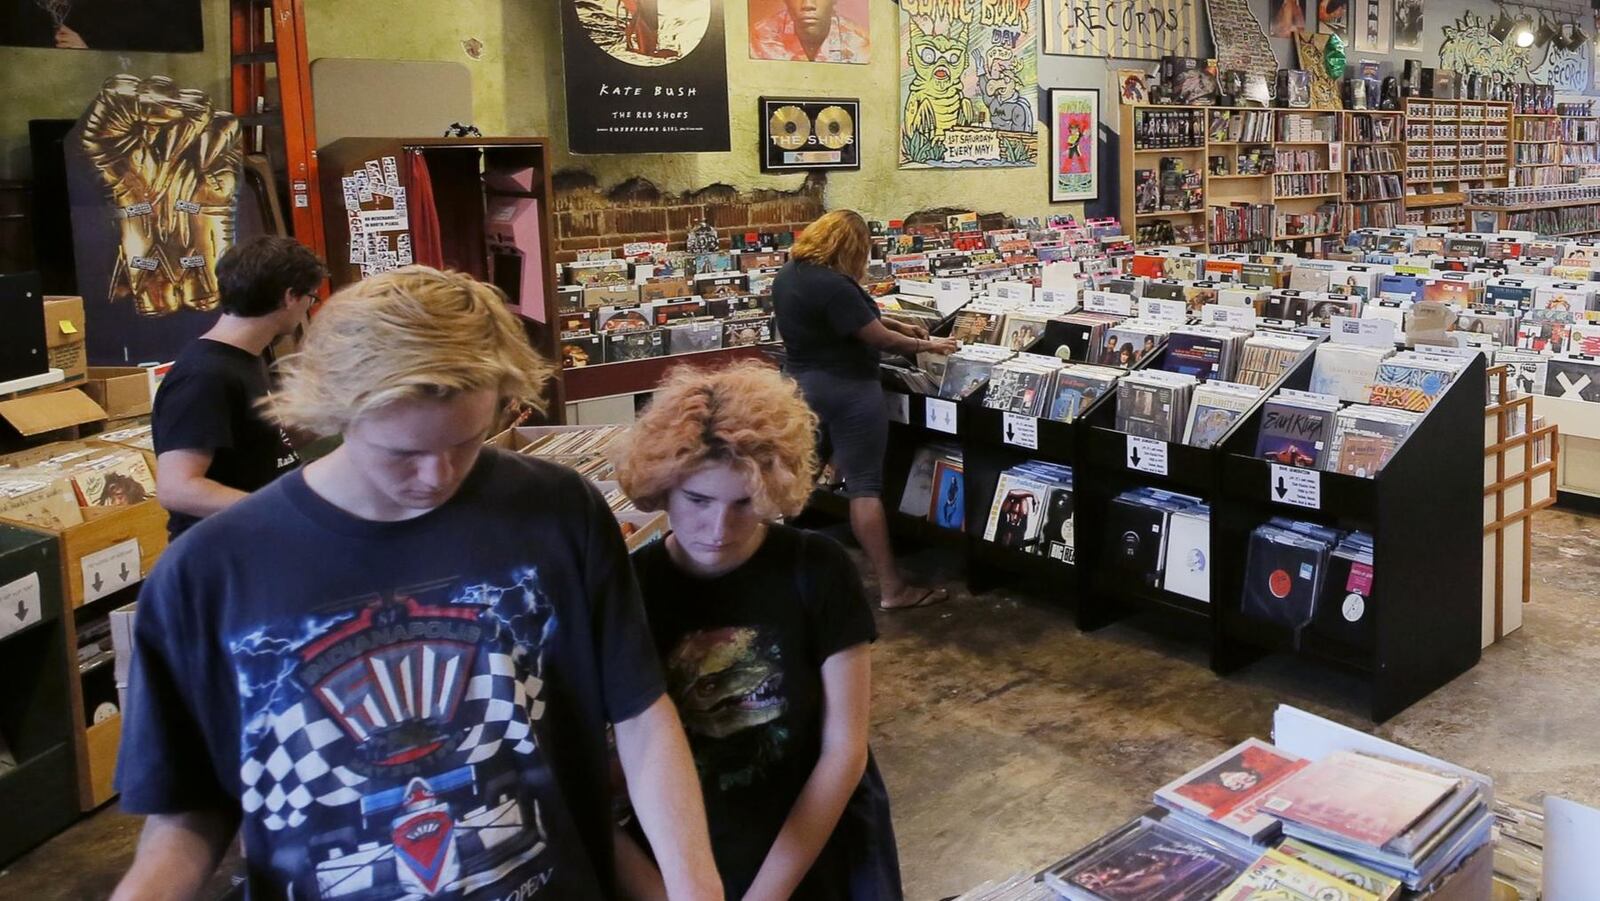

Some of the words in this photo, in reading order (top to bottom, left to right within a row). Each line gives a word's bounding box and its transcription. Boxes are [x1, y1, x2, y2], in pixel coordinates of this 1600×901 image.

[1073, 1, 1178, 37] RECORDS
[991, 28, 1021, 49] DAY
[599, 83, 642, 96] KATE
[654, 86, 697, 97] BUSH
[612, 111, 632, 119] THE
[636, 111, 653, 119] RED
[656, 111, 689, 119] SHOES
[770, 135, 801, 145] THE
[807, 135, 854, 145] SHINS
[948, 134, 959, 144] 1ST
[949, 145, 972, 158] EVERY
[975, 144, 994, 157] MAY!
[301, 620, 482, 686] INDIANAPOLIS
[317, 640, 475, 743] 500
[504, 867, 554, 901] OPEN
